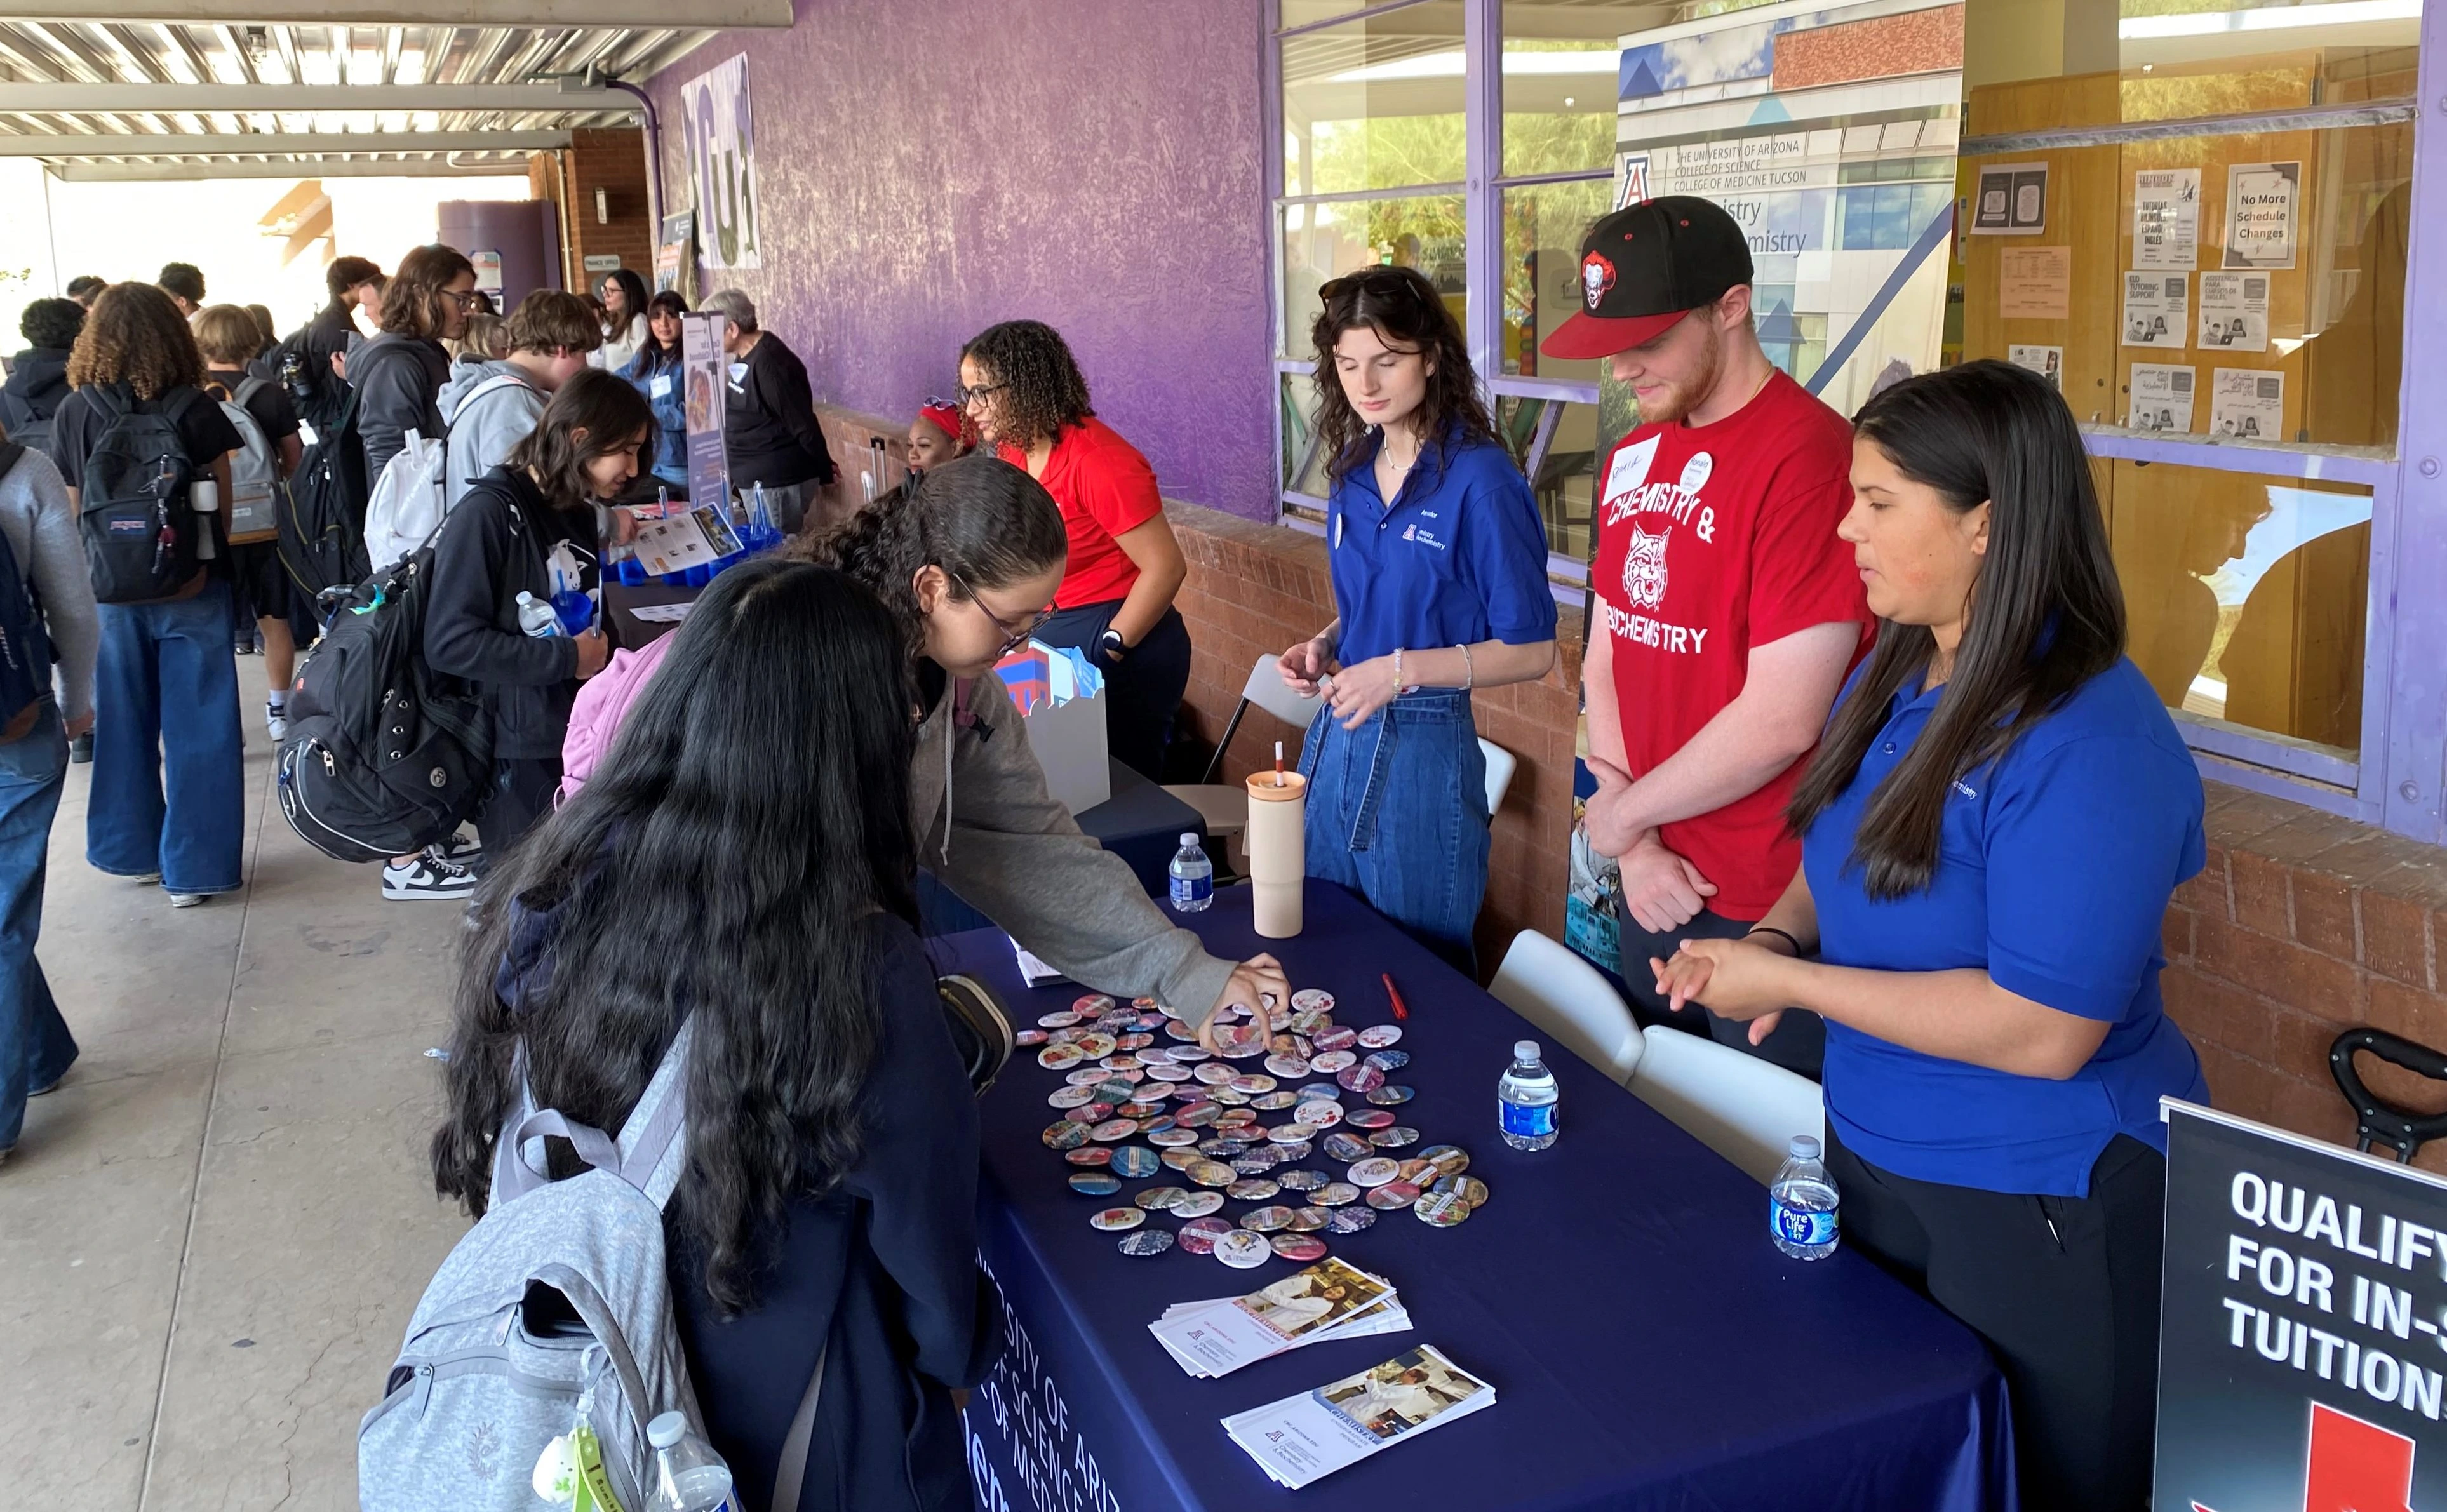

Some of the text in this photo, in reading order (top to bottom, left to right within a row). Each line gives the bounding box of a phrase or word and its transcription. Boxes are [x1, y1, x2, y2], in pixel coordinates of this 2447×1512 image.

[1677, 140, 1799, 163] THE UNIVERSITY OF ARIZONA
[1675, 159, 1761, 177] COLLEGE OF SCIENCE
[1674, 171, 1807, 192] COLLEGE OF MEDICINE TUCSON
[2241, 194, 2286, 204] No More
[1724, 199, 1761, 226] istry
[2237, 211, 2286, 222] Schedule
[1748, 230, 1807, 258] mistry
[2239, 229, 2284, 241] Changes
[1607, 483, 1715, 544] CHEMISTRY &
[1783, 1208, 1807, 1223] Pure
[1786, 1219, 1804, 1232] Life
[2227, 1234, 2447, 1355] FOR IN-
[2223, 1297, 2443, 1421] TUITION
[1045, 1376, 1068, 1442] OF
[1331, 1409, 1376, 1443] CHEMISTRY
[991, 1381, 1057, 1512] OF MED
